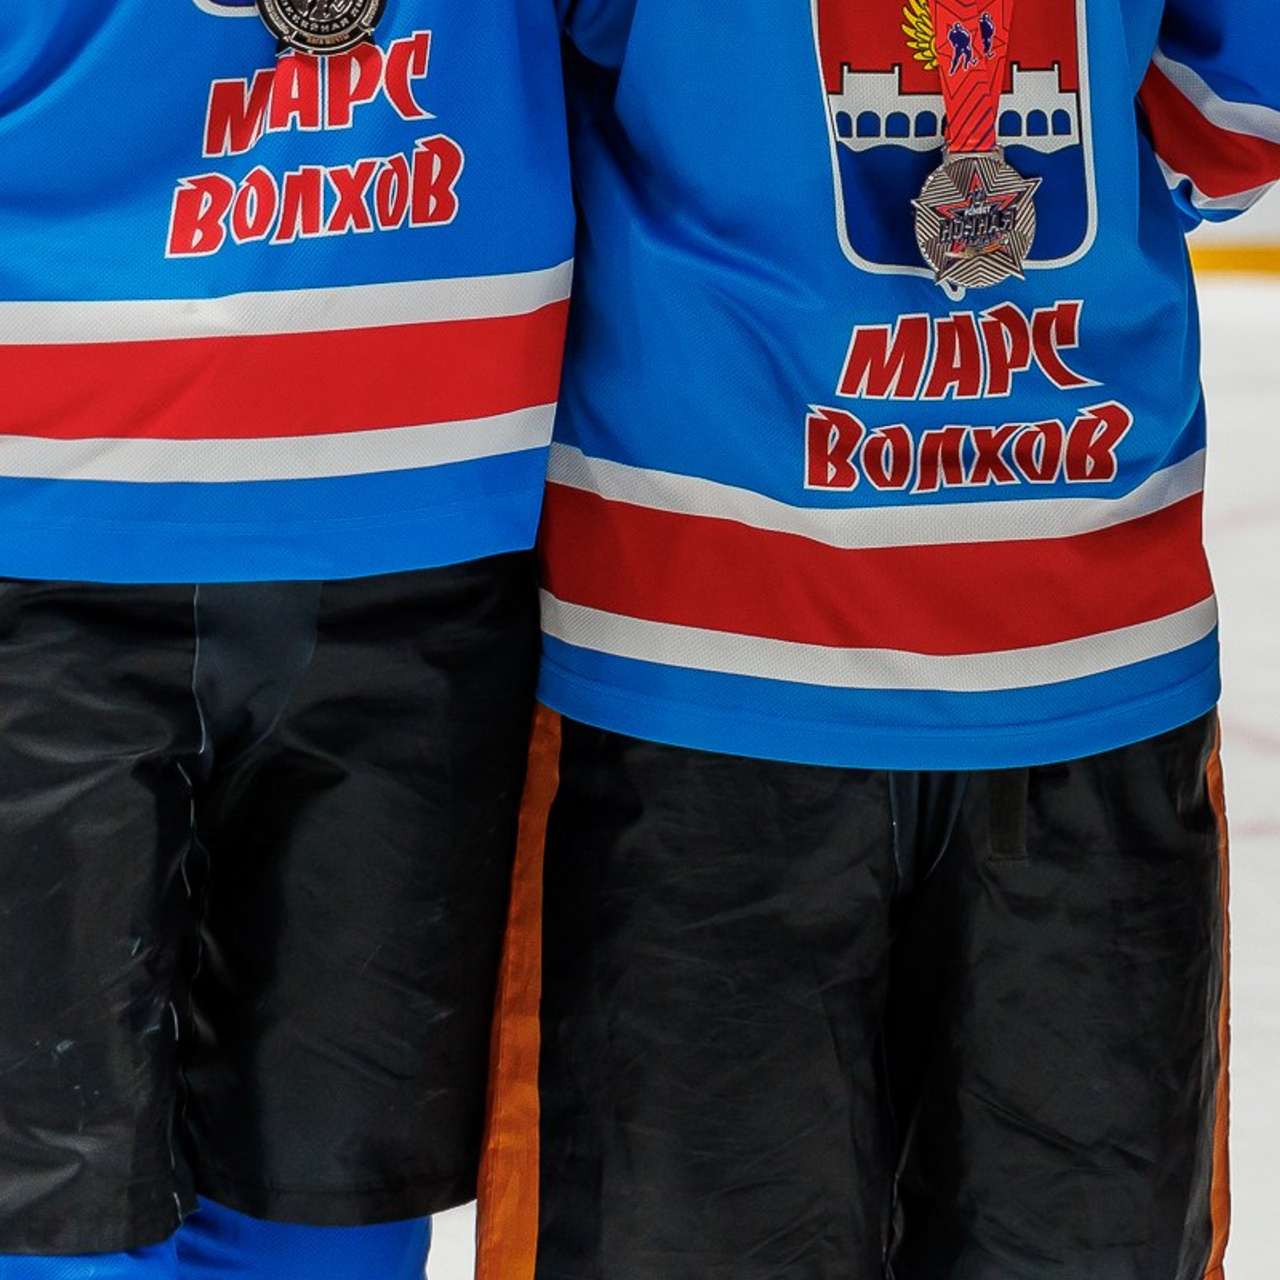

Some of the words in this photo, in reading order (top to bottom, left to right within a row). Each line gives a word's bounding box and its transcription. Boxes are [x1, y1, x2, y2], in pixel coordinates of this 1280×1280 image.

[201, 30, 437, 158] МАРС
[165, 134, 465, 258] ВОЛХОВ
[835, 299, 1104, 400] МАРС
[804, 400, 1134, 495] ВОЛХОВ
